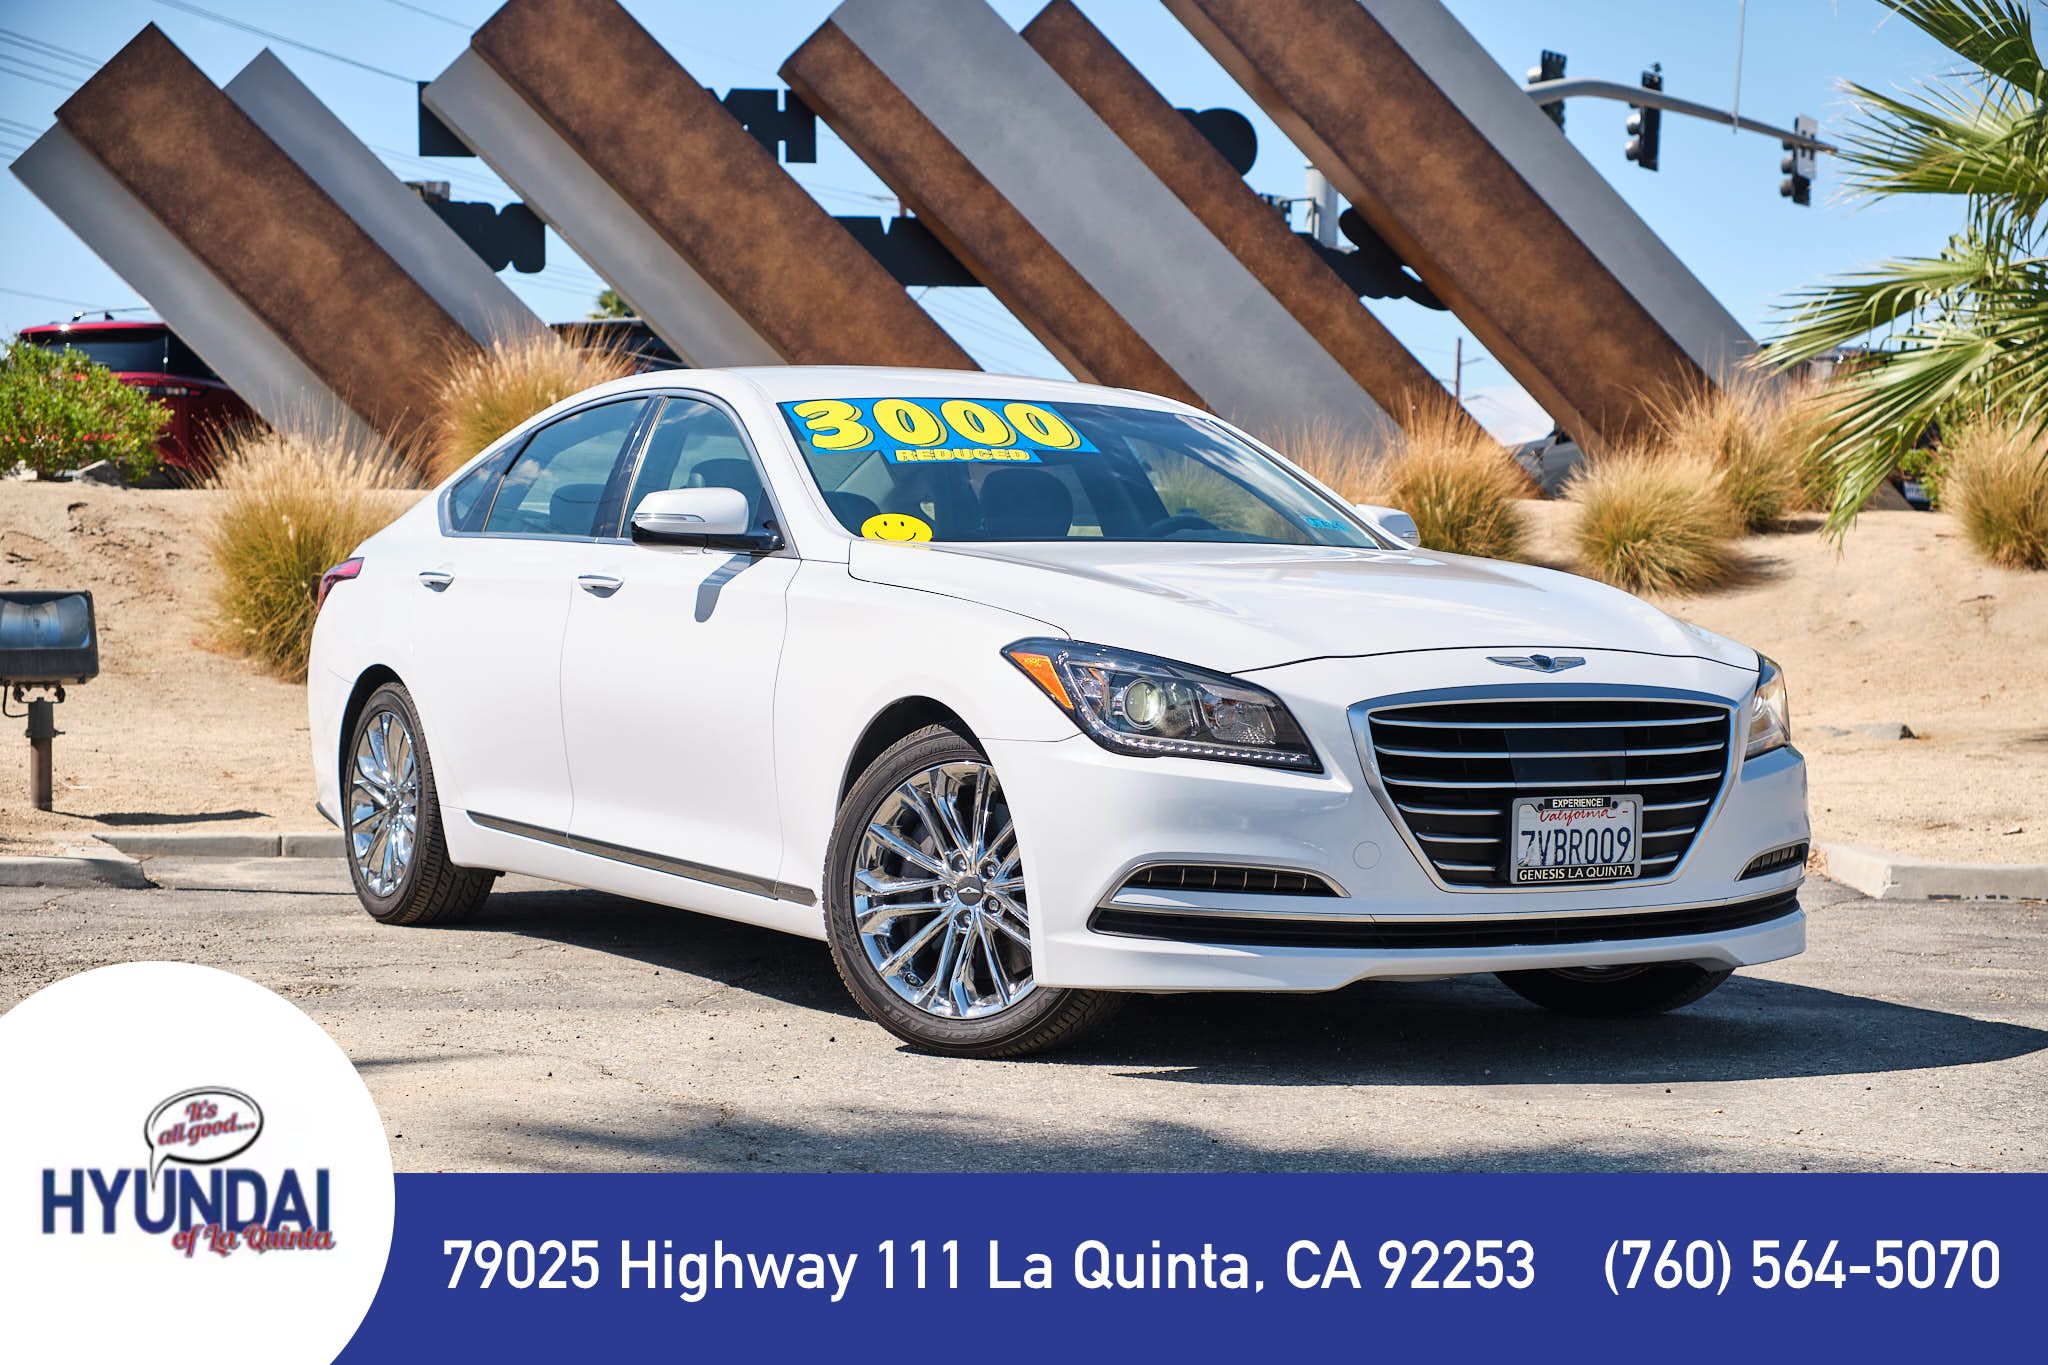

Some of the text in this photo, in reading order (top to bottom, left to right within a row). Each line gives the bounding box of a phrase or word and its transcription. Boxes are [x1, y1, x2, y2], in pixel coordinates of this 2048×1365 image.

[792, 399, 1081, 450] 3000
[895, 448, 1030, 462] REDUCED
[1539, 808, 1616, 826] California
[1521, 826, 1632, 867] 7VBR009
[1519, 865, 1633, 881] GENESIS LA QUINTA
